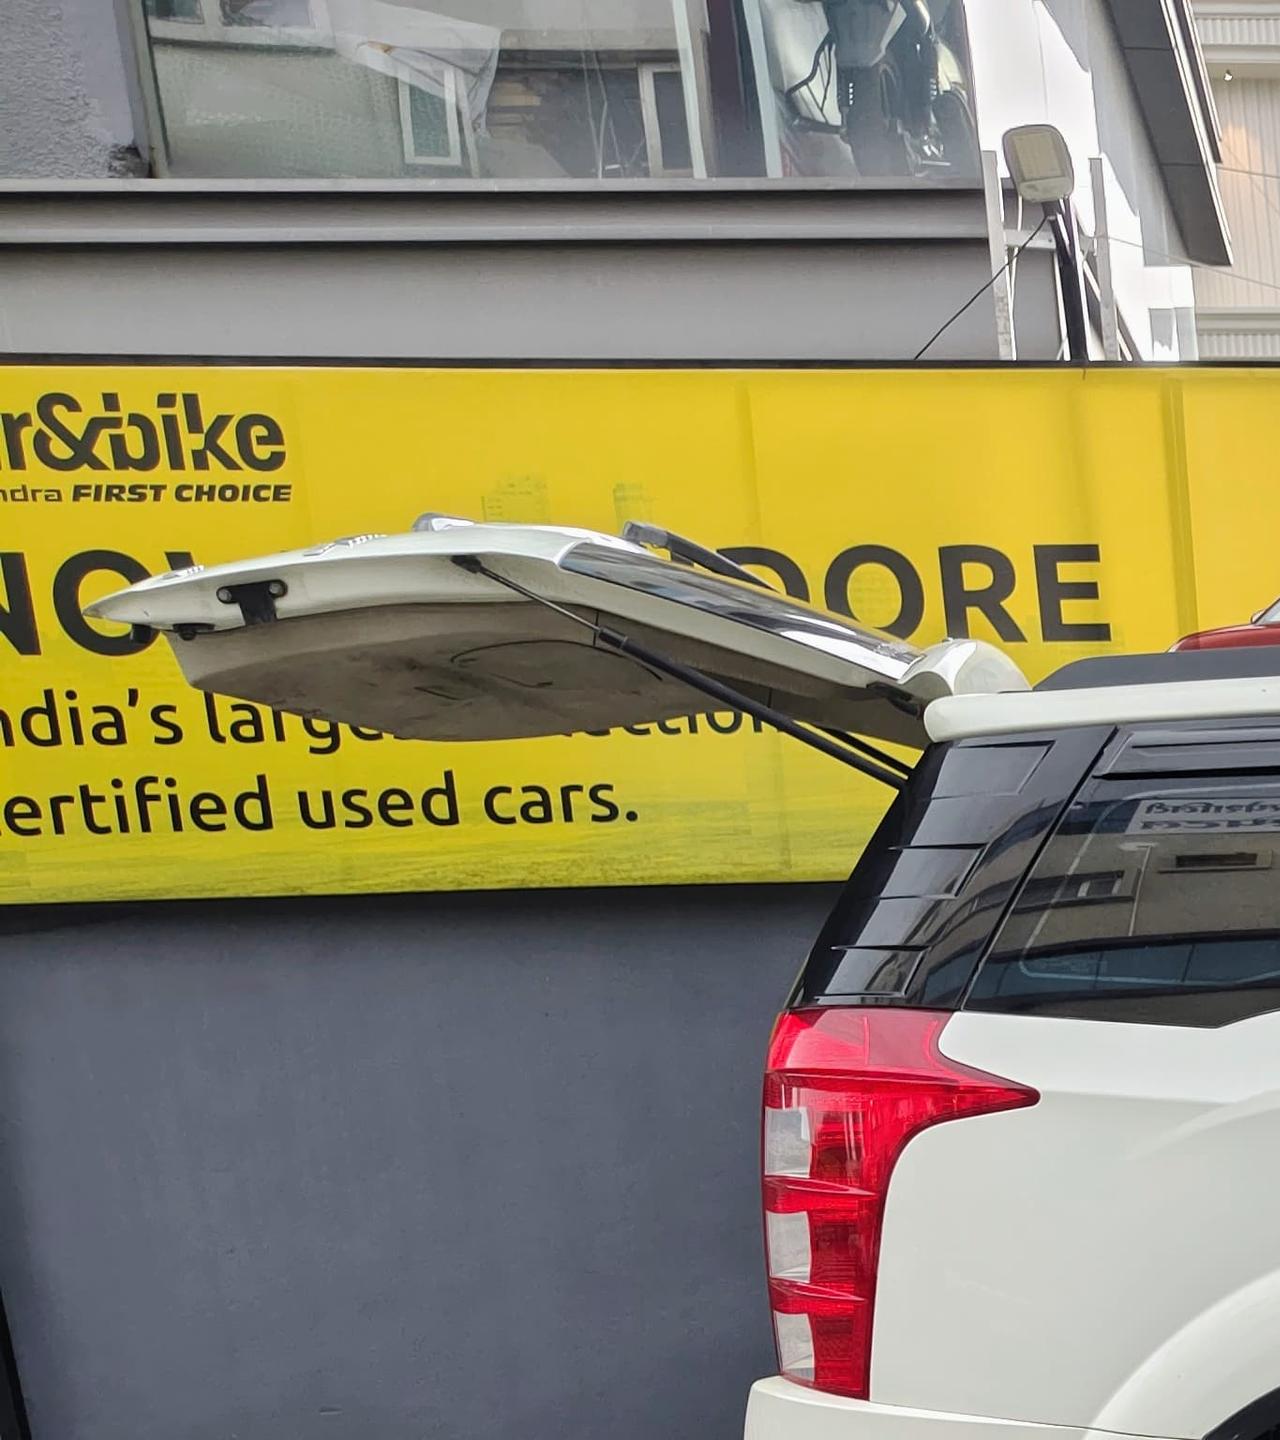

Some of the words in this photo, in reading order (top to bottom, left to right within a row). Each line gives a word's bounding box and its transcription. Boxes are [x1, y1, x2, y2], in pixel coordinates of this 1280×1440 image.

[0, 392, 286, 472] r&bike
[72, 484, 167, 502] FIRST
[174, 484, 292, 502] CHOICE
[0, 773, 274, 837] ertified
[297, 769, 460, 830] used
[484, 783, 639, 825] cars.
